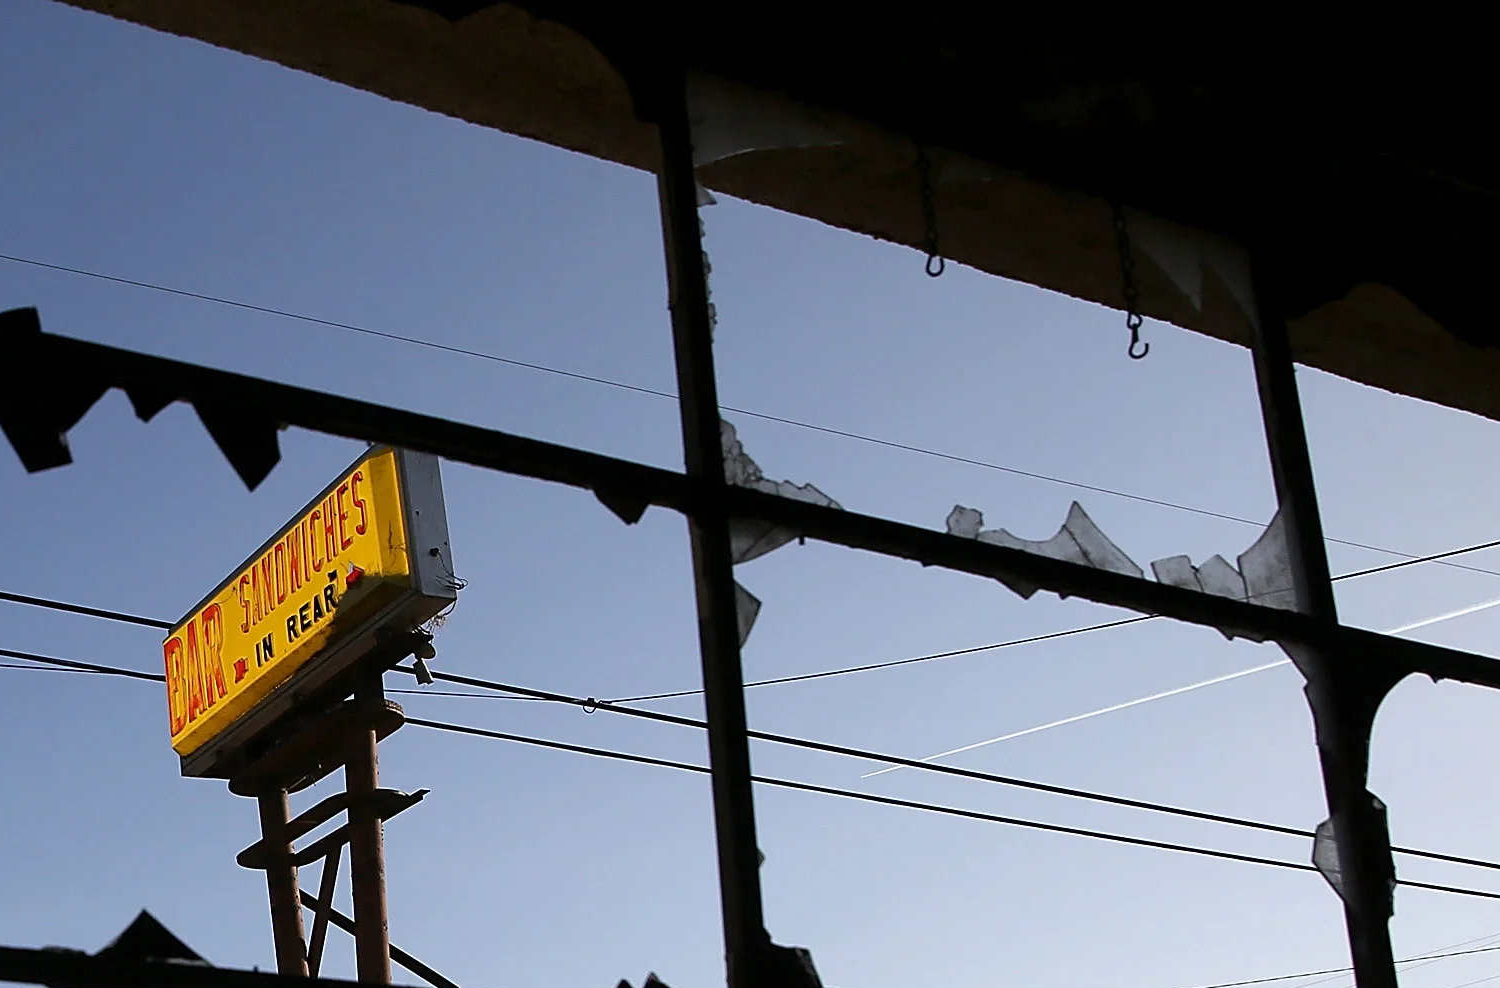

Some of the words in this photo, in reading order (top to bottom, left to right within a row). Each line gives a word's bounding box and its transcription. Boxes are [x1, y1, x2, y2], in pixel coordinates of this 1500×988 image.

[163, 602, 228, 738] BAR
[239, 470, 367, 633] SANDWICHES
[255, 632, 275, 668] IN
[286, 582, 339, 643] REAR
